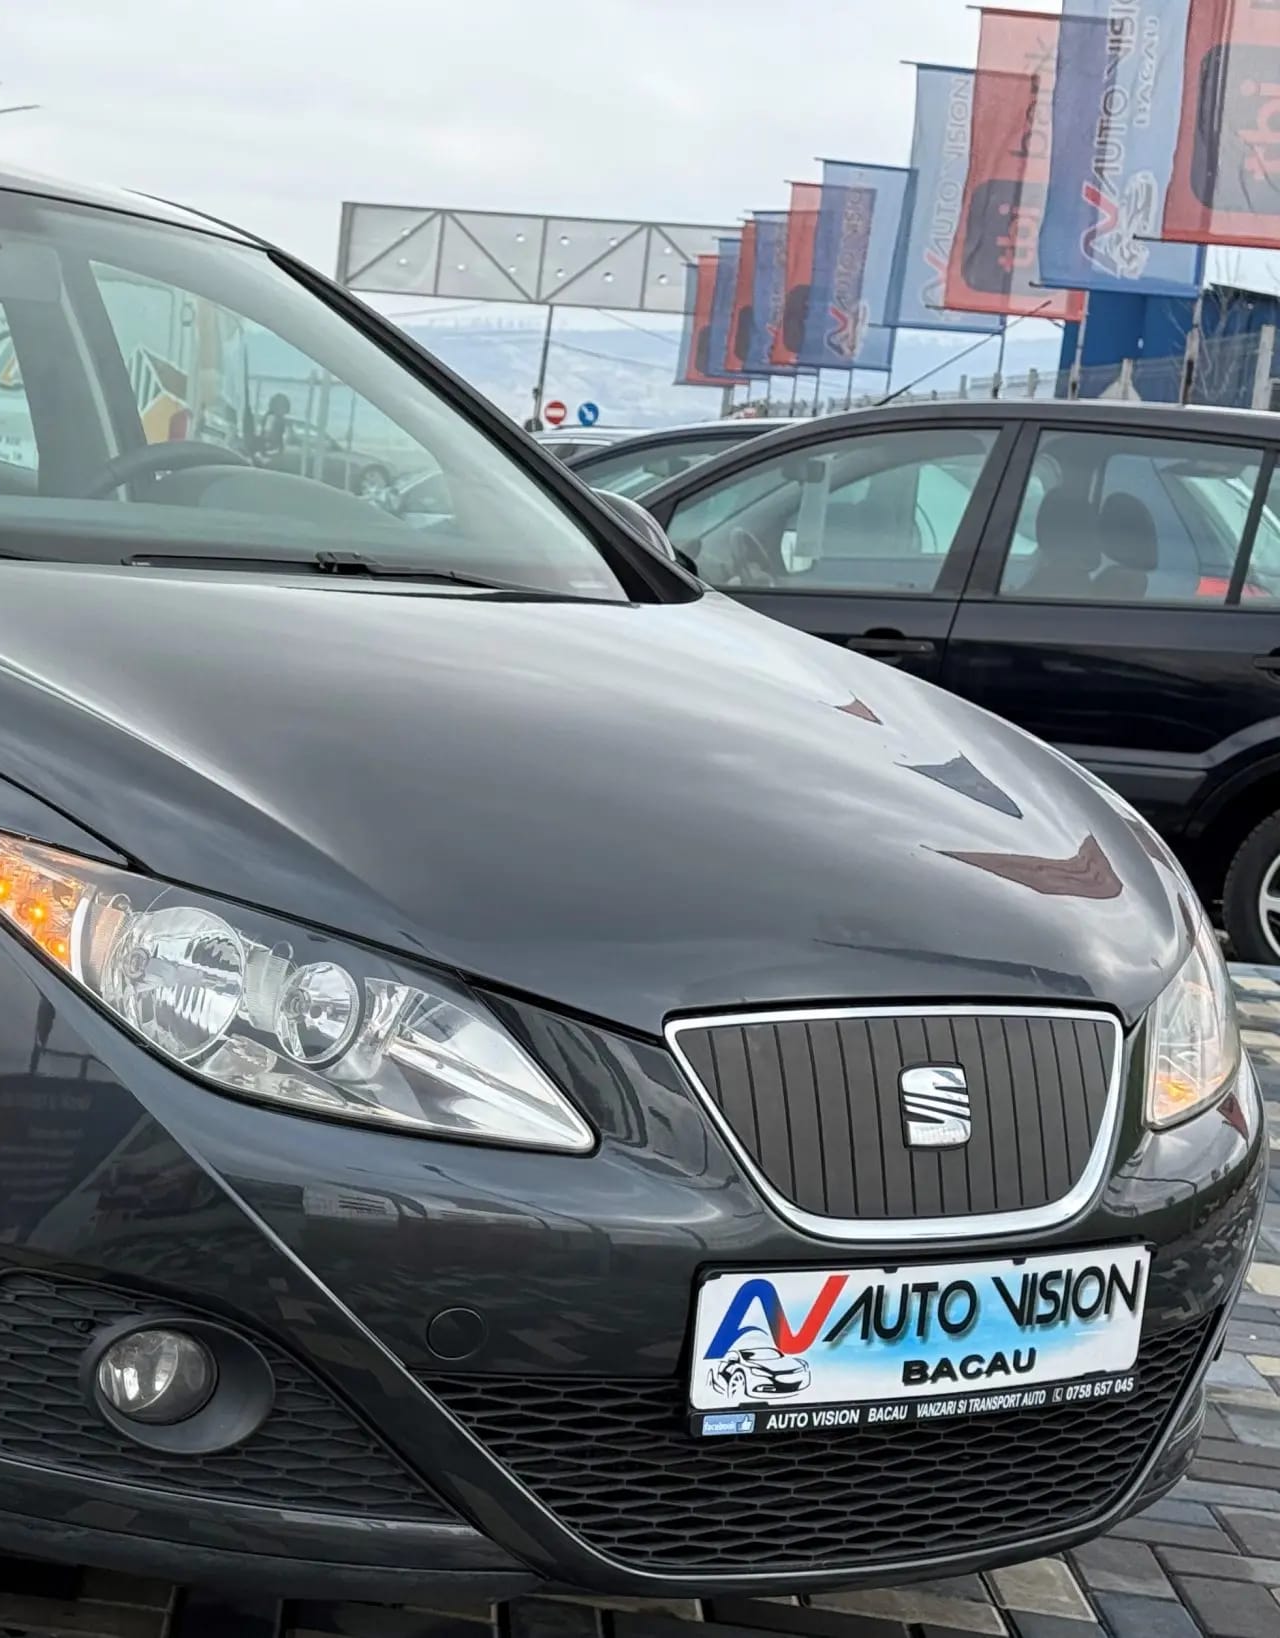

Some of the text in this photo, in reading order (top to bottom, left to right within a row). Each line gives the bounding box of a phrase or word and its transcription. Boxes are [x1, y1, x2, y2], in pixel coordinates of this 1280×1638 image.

[1103, 0, 1138, 82] VISI
[941, 76, 970, 175] VISION
[1093, 87, 1129, 198] AUTO
[929, 181, 961, 257] AUTO
[996, 203, 1039, 273] tbi
[823, 1279, 978, 1344] AUTO
[991, 1259, 1143, 1330] VISION
[766, 1377, 1135, 1430] AUTO VISION BACAU VANZARI SI TRANSPORT AUTO 0758 657 045
[902, 1347, 1038, 1387] BACAU
